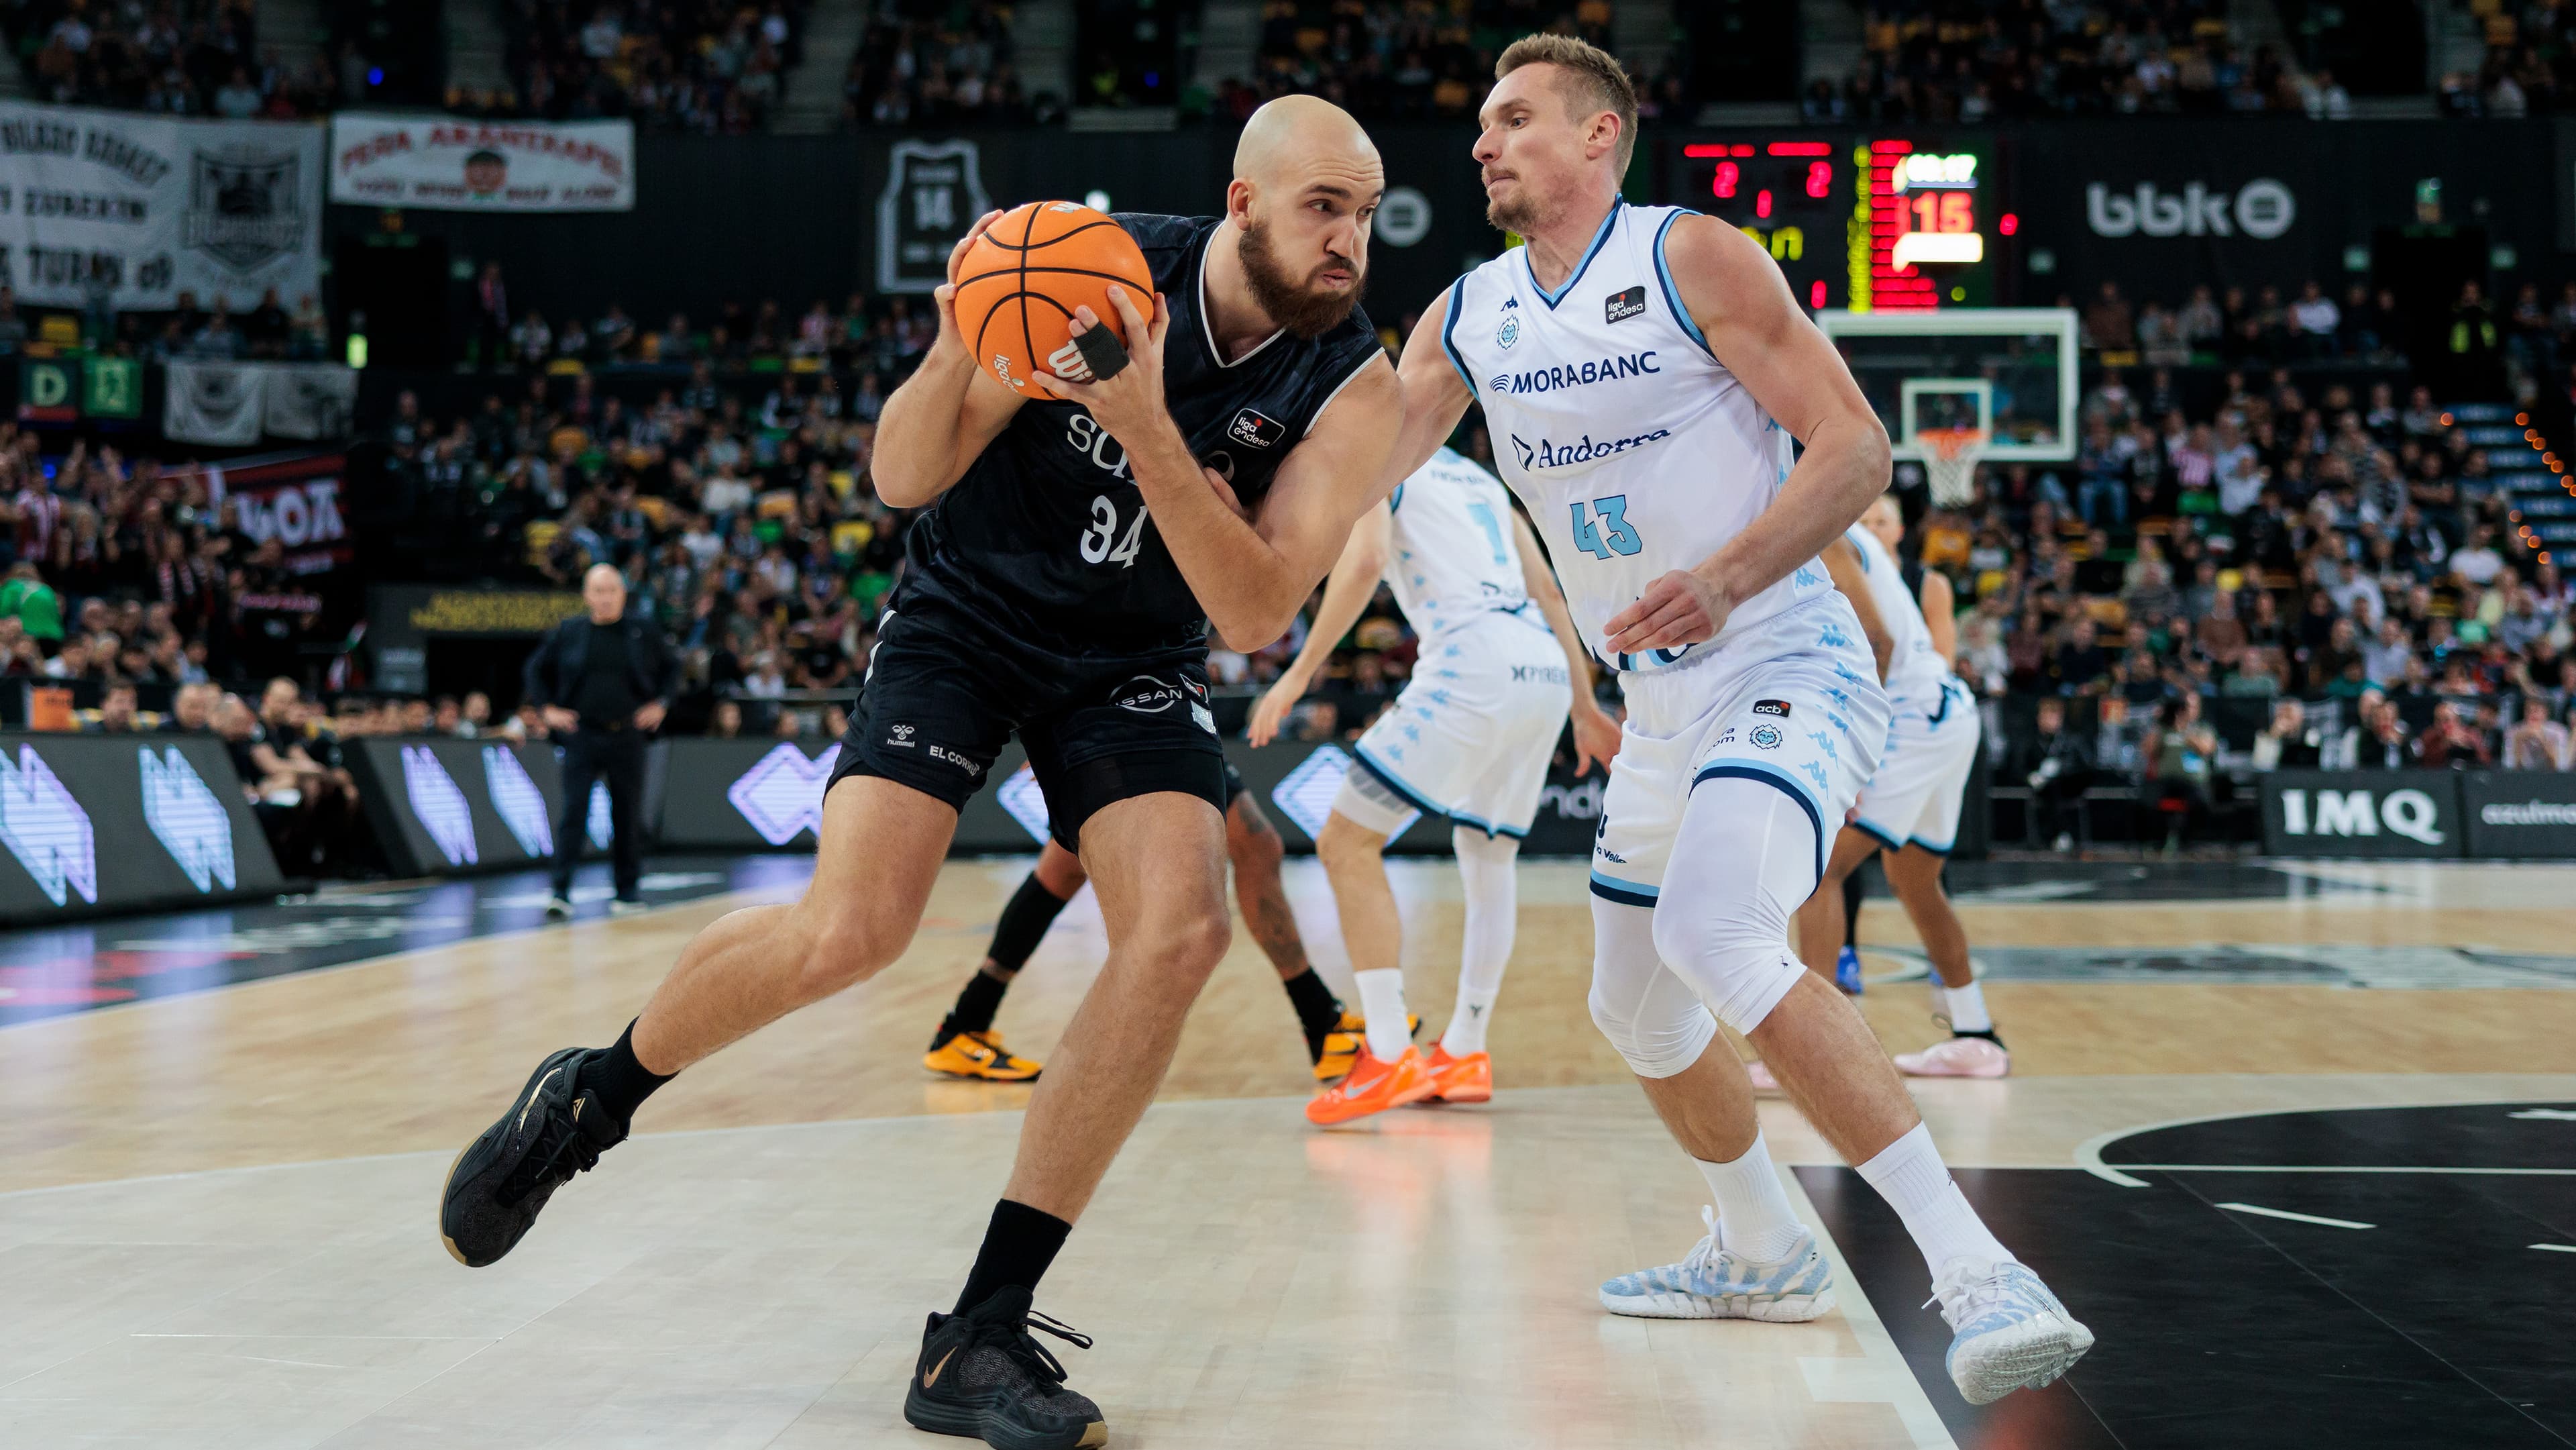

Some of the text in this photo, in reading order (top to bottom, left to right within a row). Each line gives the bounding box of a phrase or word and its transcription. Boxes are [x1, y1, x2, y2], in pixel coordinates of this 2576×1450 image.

[2086, 180, 2233, 237] bbk
[1608, 301, 1624, 311] liga
[1609, 303, 1643, 320] endesa
[1511, 351, 1661, 395] MORABANC
[1238, 417, 1258, 433] liga
[1234, 427, 1270, 447] endesa
[1539, 429, 1670, 468] Andorra
[1080, 495, 1148, 569] 34
[1570, 495, 1642, 560] 43
[1116, 689, 1183, 706] SSAN
[1756, 704, 1782, 715] acb
[887, 738, 915, 748] hummel
[930, 745, 946, 760] EL
[2282, 788, 2445, 845] IMQ
